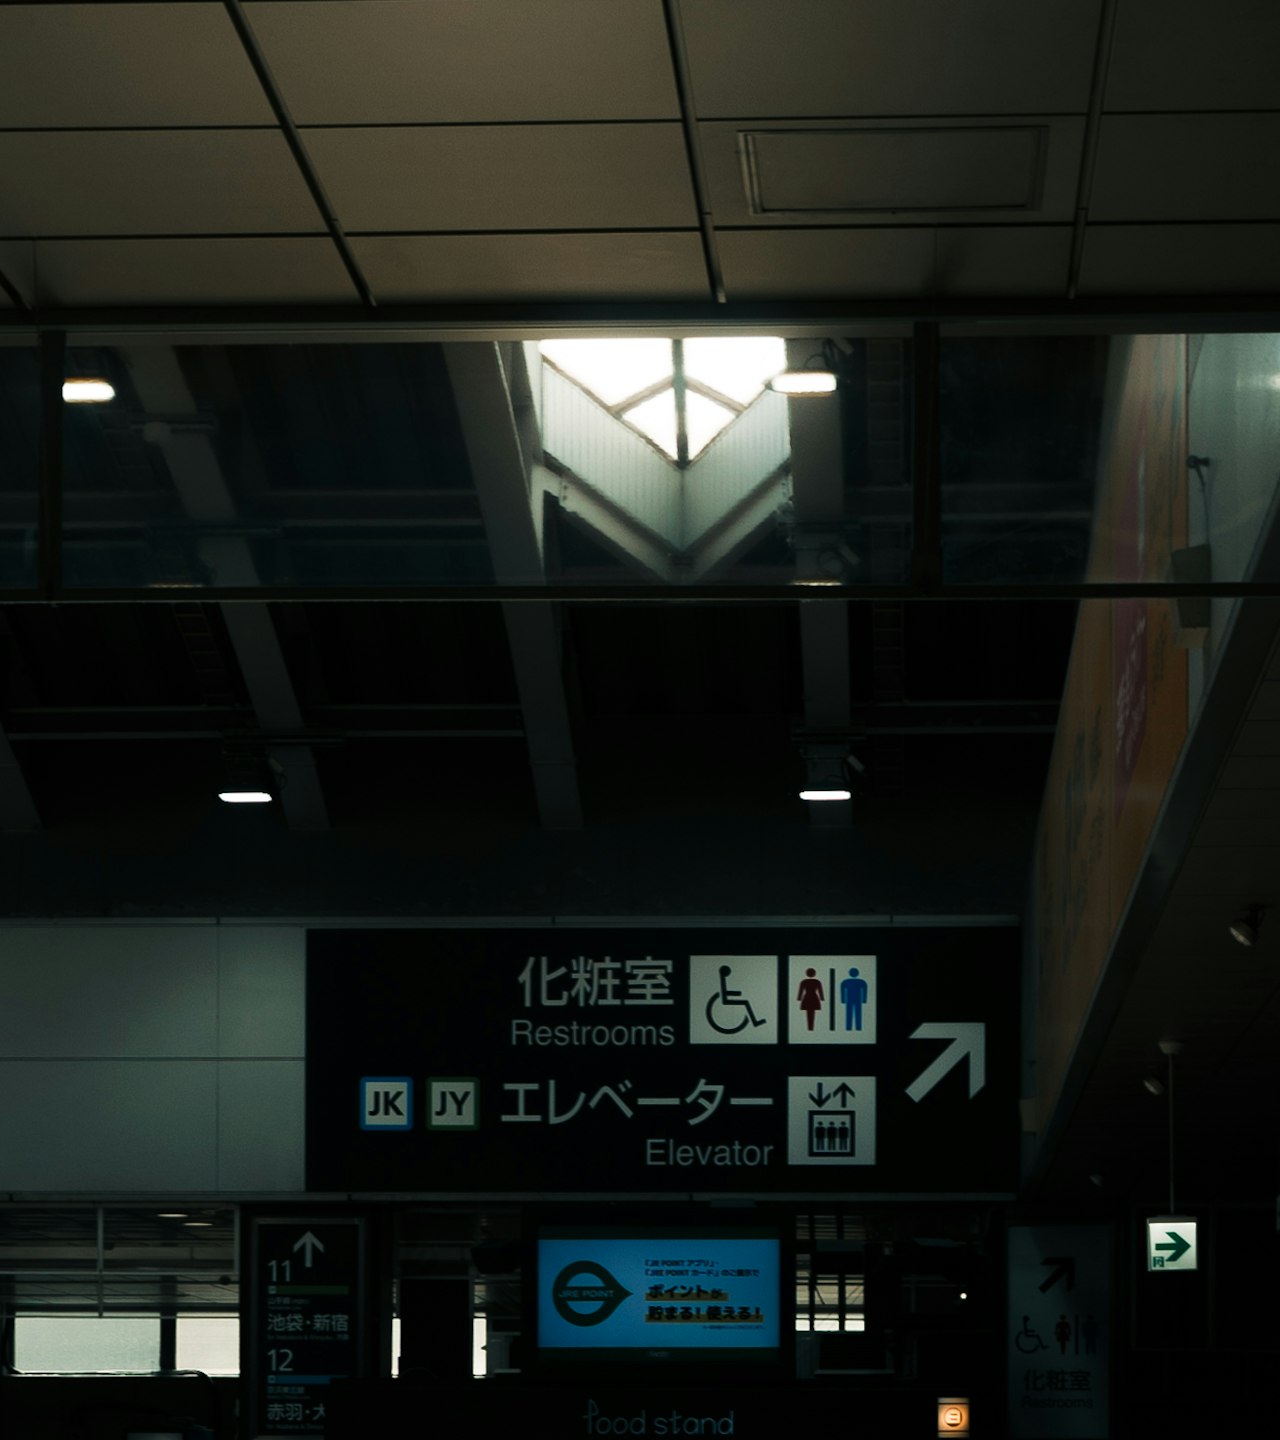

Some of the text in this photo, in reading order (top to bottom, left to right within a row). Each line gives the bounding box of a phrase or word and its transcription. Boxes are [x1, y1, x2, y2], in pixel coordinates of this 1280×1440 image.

[517, 955, 675, 1008] 化粧室
[511, 1019, 675, 1047] Restrooms
[369, 1090, 403, 1117] JK
[435, 1090, 469, 1117] JY
[501, 1078, 775, 1128] エレベーター
[645, 1138, 775, 1167] Elevator
[267, 1259, 293, 1282] 11
[267, 1313, 350, 1332] 池袋・新宿
[267, 1348, 295, 1372] 12
[1023, 1369, 1091, 1392] 化粧室
[1021, 1395, 1094, 1410] Restrooms
[581, 1398, 736, 1437] food stand
